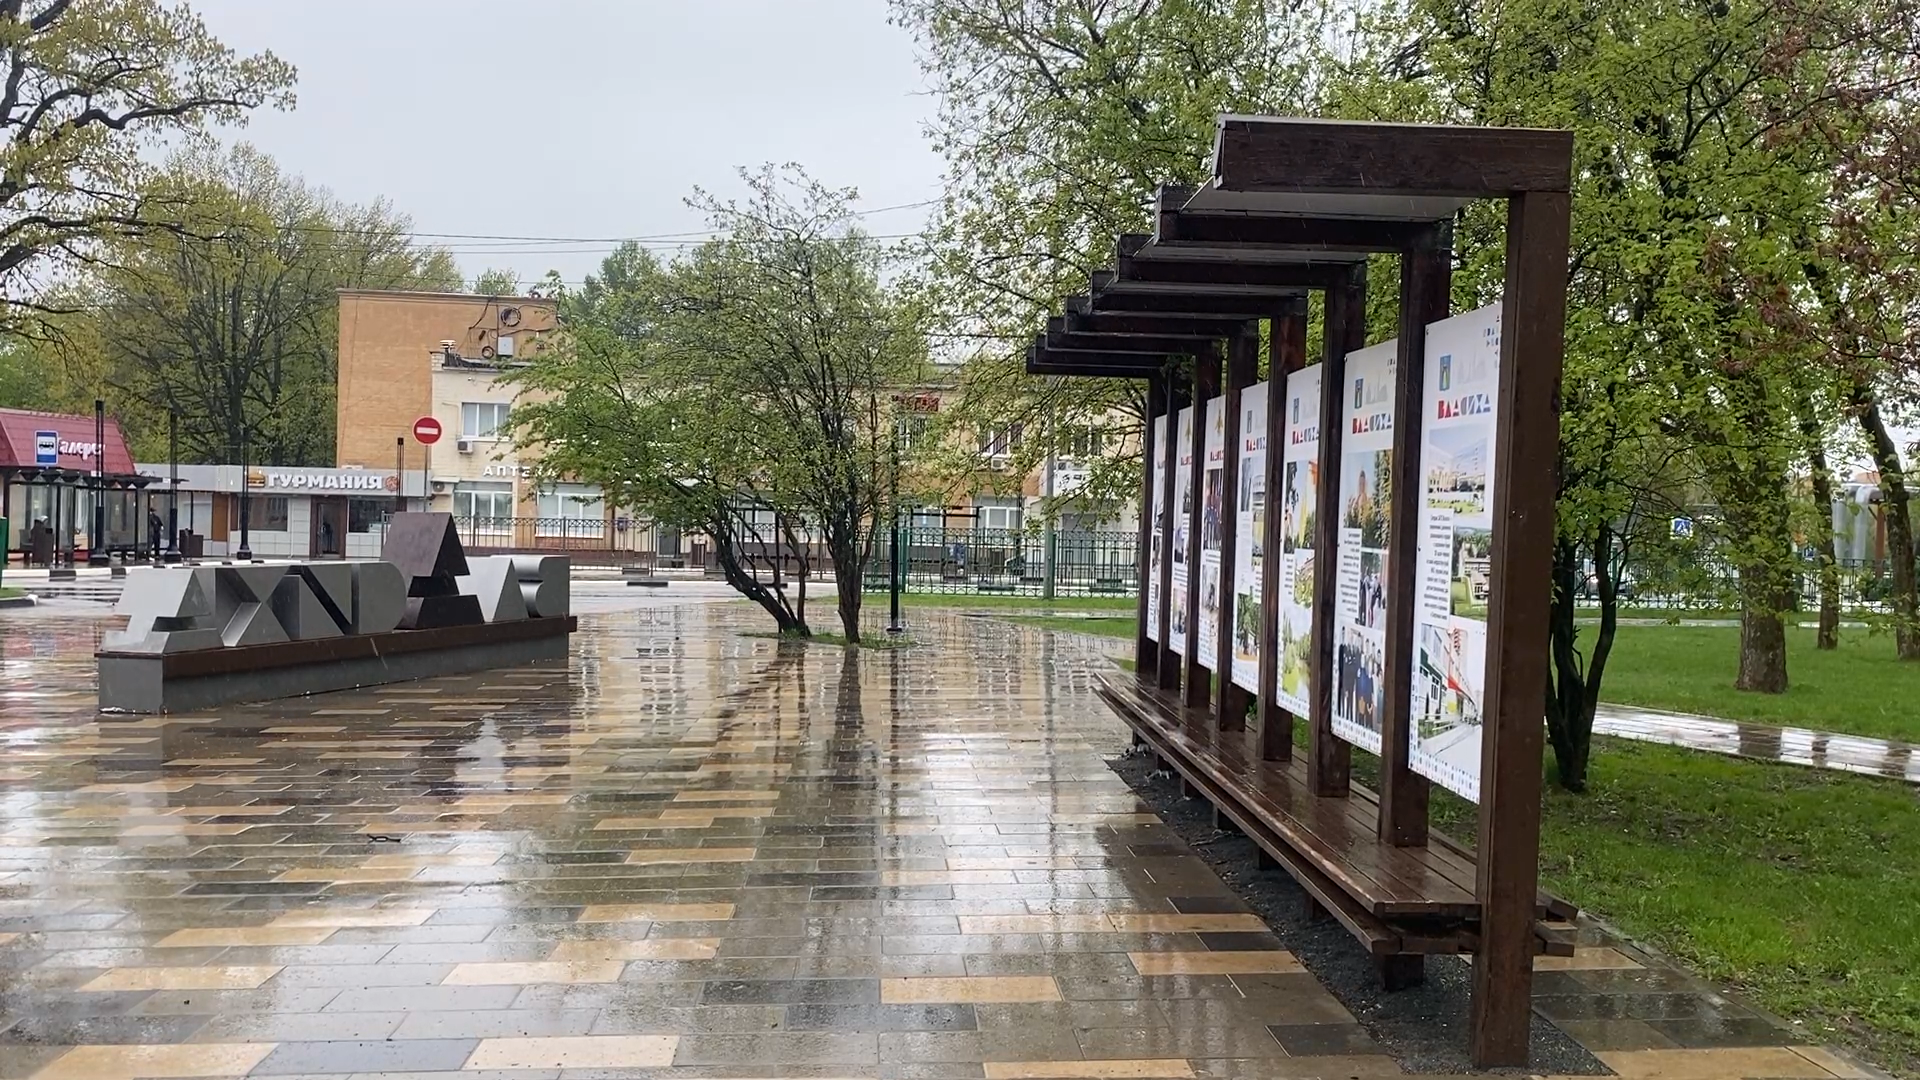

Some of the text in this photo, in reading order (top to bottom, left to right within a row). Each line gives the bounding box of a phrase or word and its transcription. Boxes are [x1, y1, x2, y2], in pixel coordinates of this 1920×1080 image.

[1437, 393, 1492, 419] ВЛАСИХА
[1352, 412, 1393, 435] ВЛАСИХА
[267, 473, 383, 490] ГУРМАНИЯ
